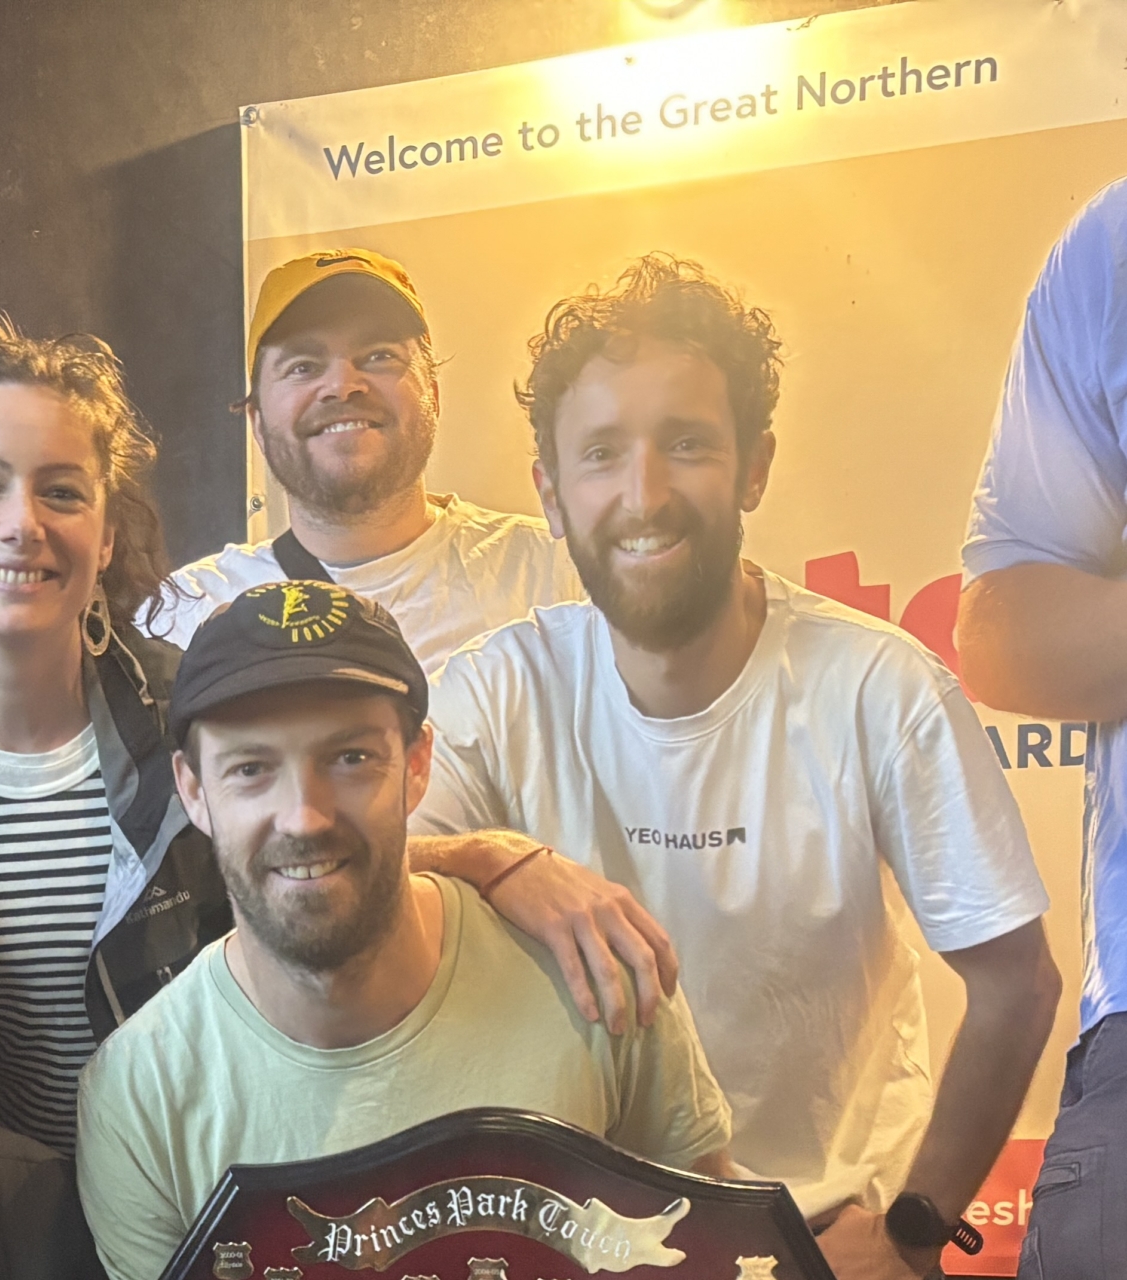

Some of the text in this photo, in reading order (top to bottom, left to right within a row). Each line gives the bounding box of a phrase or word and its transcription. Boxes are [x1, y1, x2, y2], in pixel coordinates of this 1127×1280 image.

[323, 56, 1000, 182] Welcome to the Great Northern
[318, 1186, 633, 1263] Princes Park Touch
